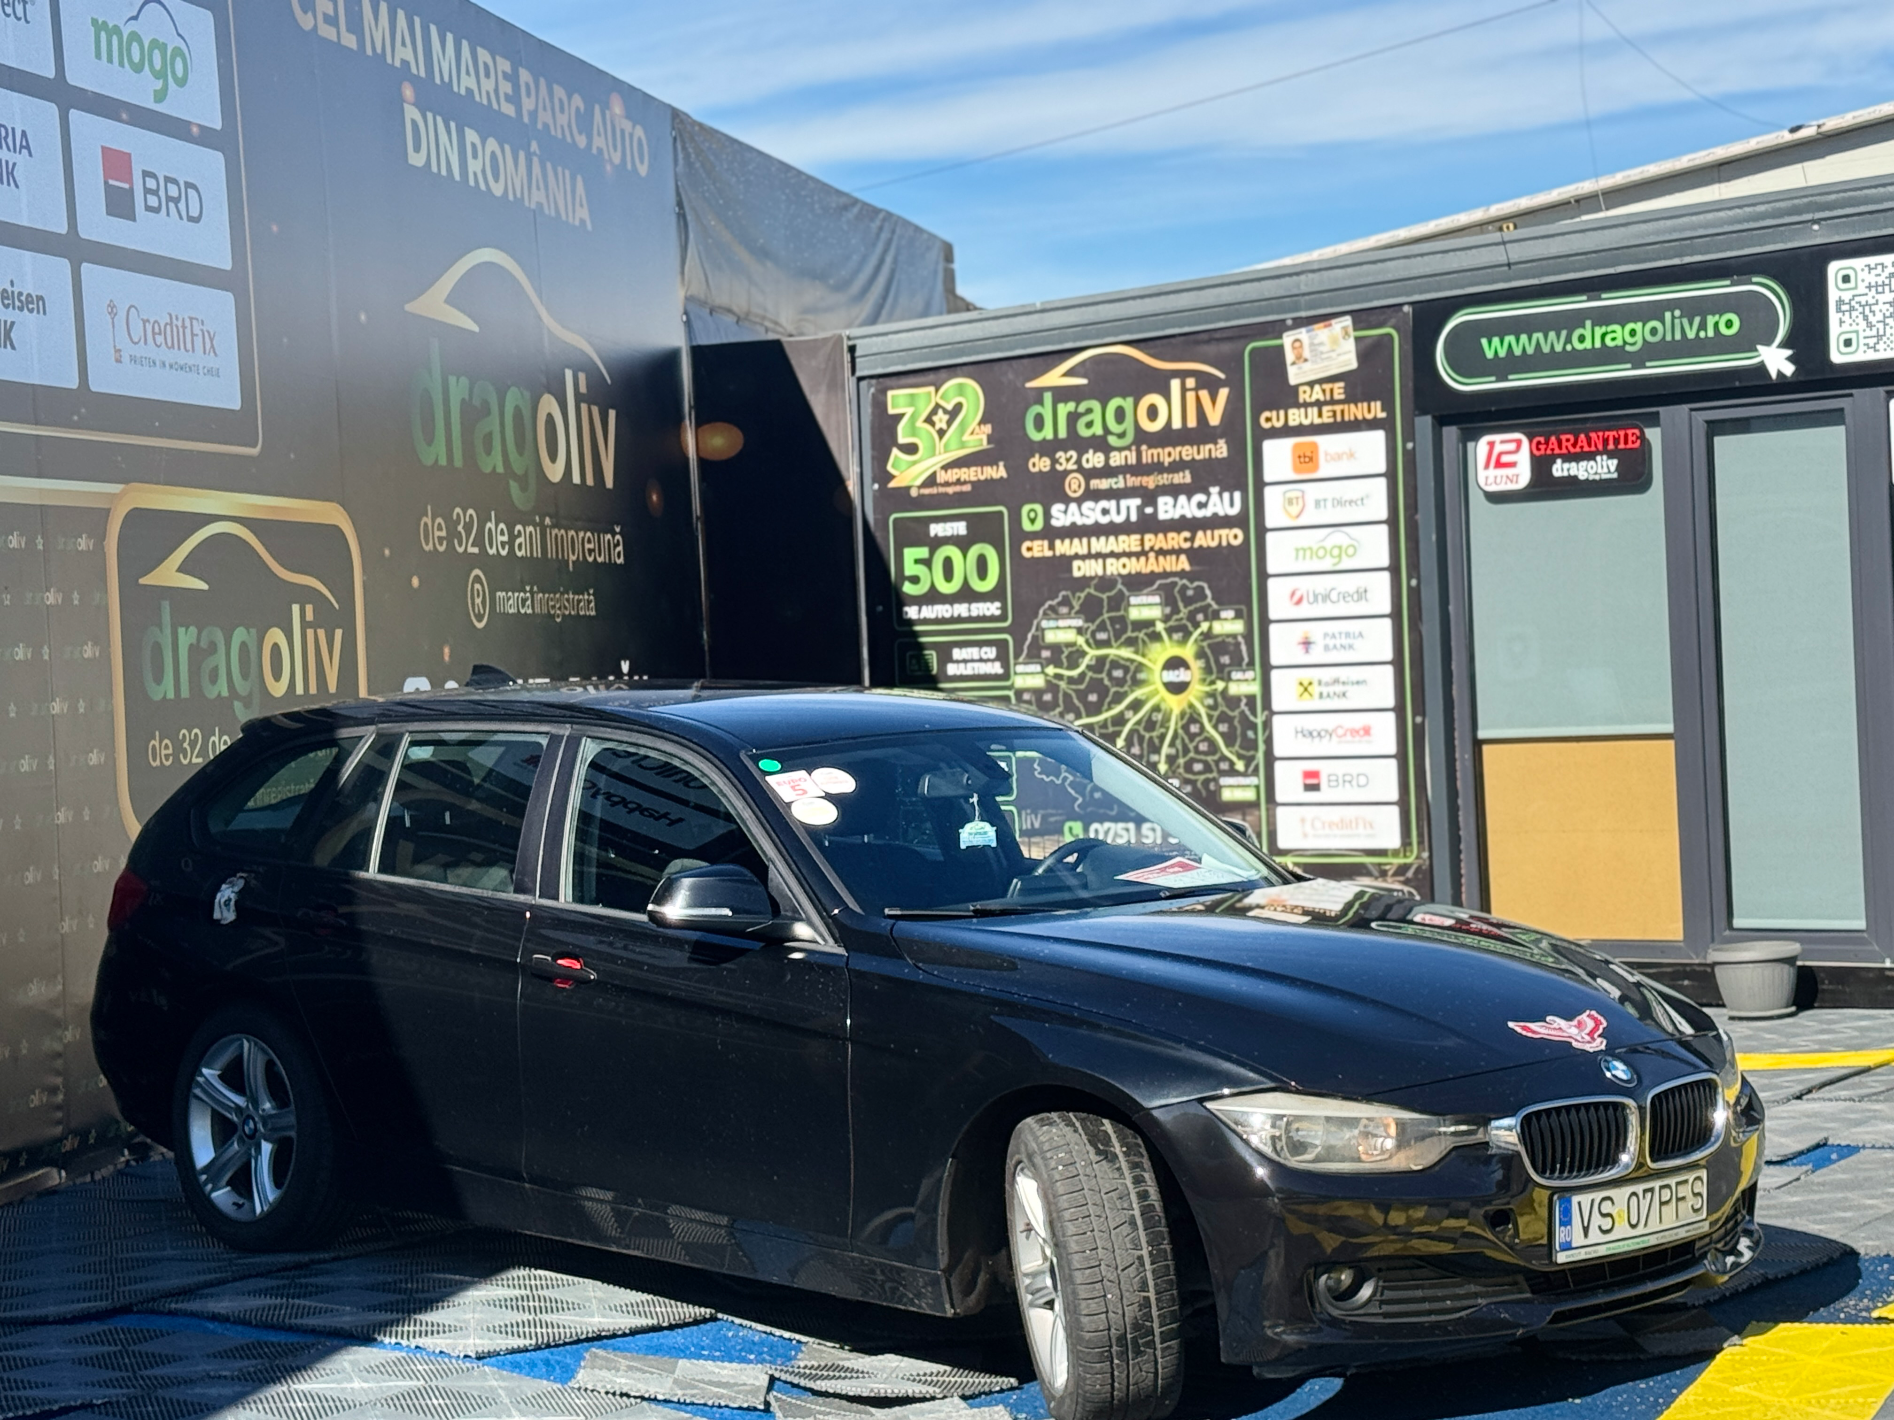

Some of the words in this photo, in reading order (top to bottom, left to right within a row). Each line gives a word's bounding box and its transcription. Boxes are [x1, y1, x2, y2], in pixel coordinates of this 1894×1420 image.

[91, 17, 189, 103] mogo
[362, 0, 425, 78] MAI
[429, 23, 516, 118] MARE
[518, 66, 587, 149] PARC
[592, 103, 649, 177] AUTO
[403, 101, 460, 181] DIN
[464, 126, 592, 231] ROMÂNIA
[142, 169, 203, 223] BRD
[126, 304, 218, 357] CreditFix
[1480, 309, 1741, 360] www.dragoliv.ro
[129, 354, 156, 367] PRIETEN
[168, 362, 200, 375] MOMENTE
[202, 365, 221, 378] CHEIE
[1298, 382, 1346, 403] RATE
[411, 336, 616, 512] dragoliv
[1025, 377, 1230, 447] dragoliv
[1259, 409, 1285, 429] CU
[1287, 400, 1387, 427] BULETINUL
[1483, 438, 1522, 471] 12
[1531, 428, 1641, 456] GARANTIE
[1028, 453, 1051, 472] de
[1055, 450, 1078, 471] 32
[1082, 449, 1105, 468] de
[1109, 446, 1136, 466] ani
[1140, 439, 1228, 467] împreună
[1297, 451, 1314, 464] tbi
[1324, 449, 1356, 463] bank
[1552, 454, 1619, 480] dragoliv
[1090, 475, 1125, 490] marcă
[1126, 470, 1192, 489] înregistrată
[1484, 474, 1520, 487] LUNI
[1050, 498, 1141, 527] SASCUT
[1156, 486, 1242, 520] BACĂU
[1314, 498, 1329, 510] BT
[420, 505, 446, 552] de
[452, 507, 479, 553] 32
[485, 511, 509, 557] de
[515, 516, 541, 558] ani
[545, 516, 624, 571] împreună
[929, 521, 967, 537] PESTE
[1021, 540, 1053, 558] CEL
[1055, 538, 1088, 556] MAI
[1092, 535, 1142, 554] MARE
[1144, 532, 1191, 551] PARC
[1193, 528, 1243, 548] AUTO
[1294, 544, 1357, 567] mogo
[902, 543, 999, 596] 500
[1072, 559, 1102, 577] DIN
[1105, 551, 1191, 575] ROMÂNIA
[496, 585, 532, 613] marcă
[533, 586, 596, 622] înregistrată
[1306, 586, 1369, 605] UniCredit
[902, 604, 919, 619] DE
[919, 602, 952, 619] AUTO
[952, 602, 969, 617] PE
[970, 601, 1002, 617] STOC
[1323, 631, 1364, 641] PATRIA
[1323, 642, 1357, 653] BANK
[142, 600, 343, 723] dragoliv
[952, 647, 980, 661] RATE
[980, 646, 997, 660] CU
[946, 661, 1005, 675] BULETINUL
[1318, 690, 1349, 700] BANK
[1295, 724, 1373, 742] HappyCredit
[148, 731, 173, 767] de
[179, 728, 203, 765] 32
[208, 727, 231, 761] de
[776, 777, 807, 787] EURO
[790, 784, 808, 796] 5
[1327, 773, 1370, 788] BRD
[1089, 821, 1136, 844] 0751
[1311, 816, 1375, 831] CreditFix
[1577, 1196, 1616, 1239] VS
[1560, 1225, 1572, 1243] RO
